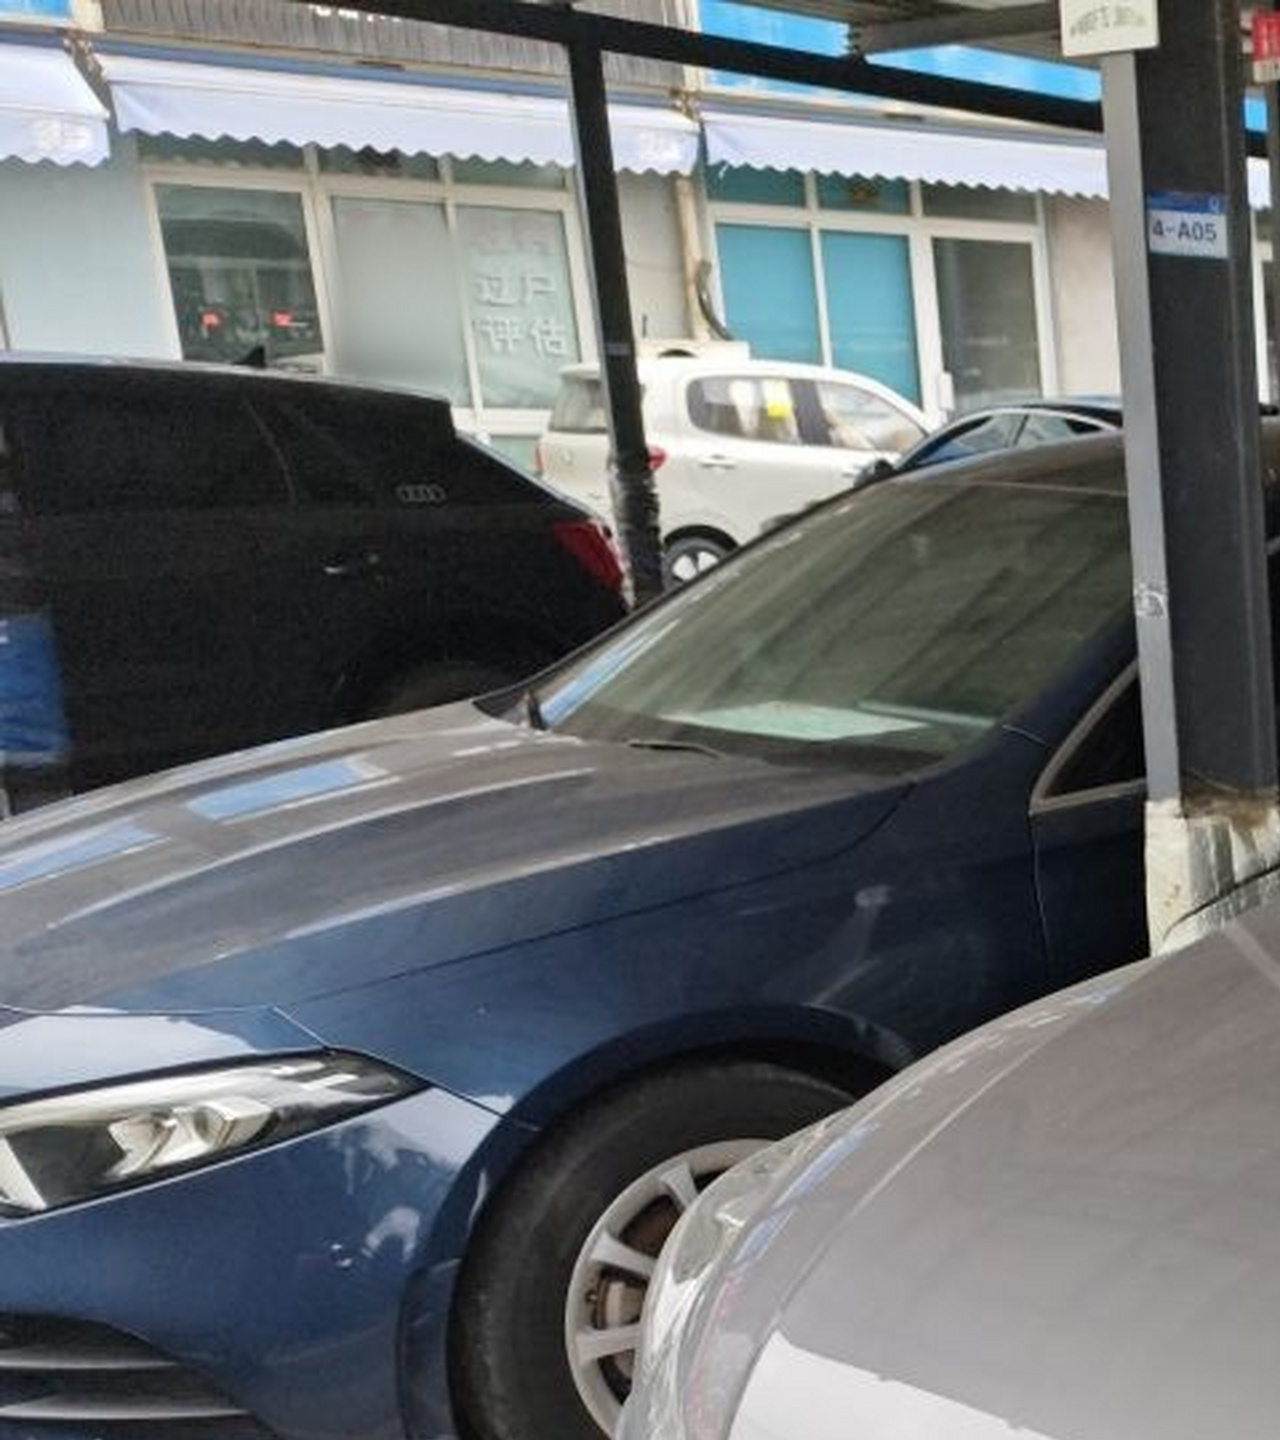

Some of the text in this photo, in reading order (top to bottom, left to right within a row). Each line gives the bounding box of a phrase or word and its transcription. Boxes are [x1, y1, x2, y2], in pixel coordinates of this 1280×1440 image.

[1152, 219, 1217, 241] 4-A05
[475, 272, 556, 308] 过户
[471, 318, 569, 359] 评估
